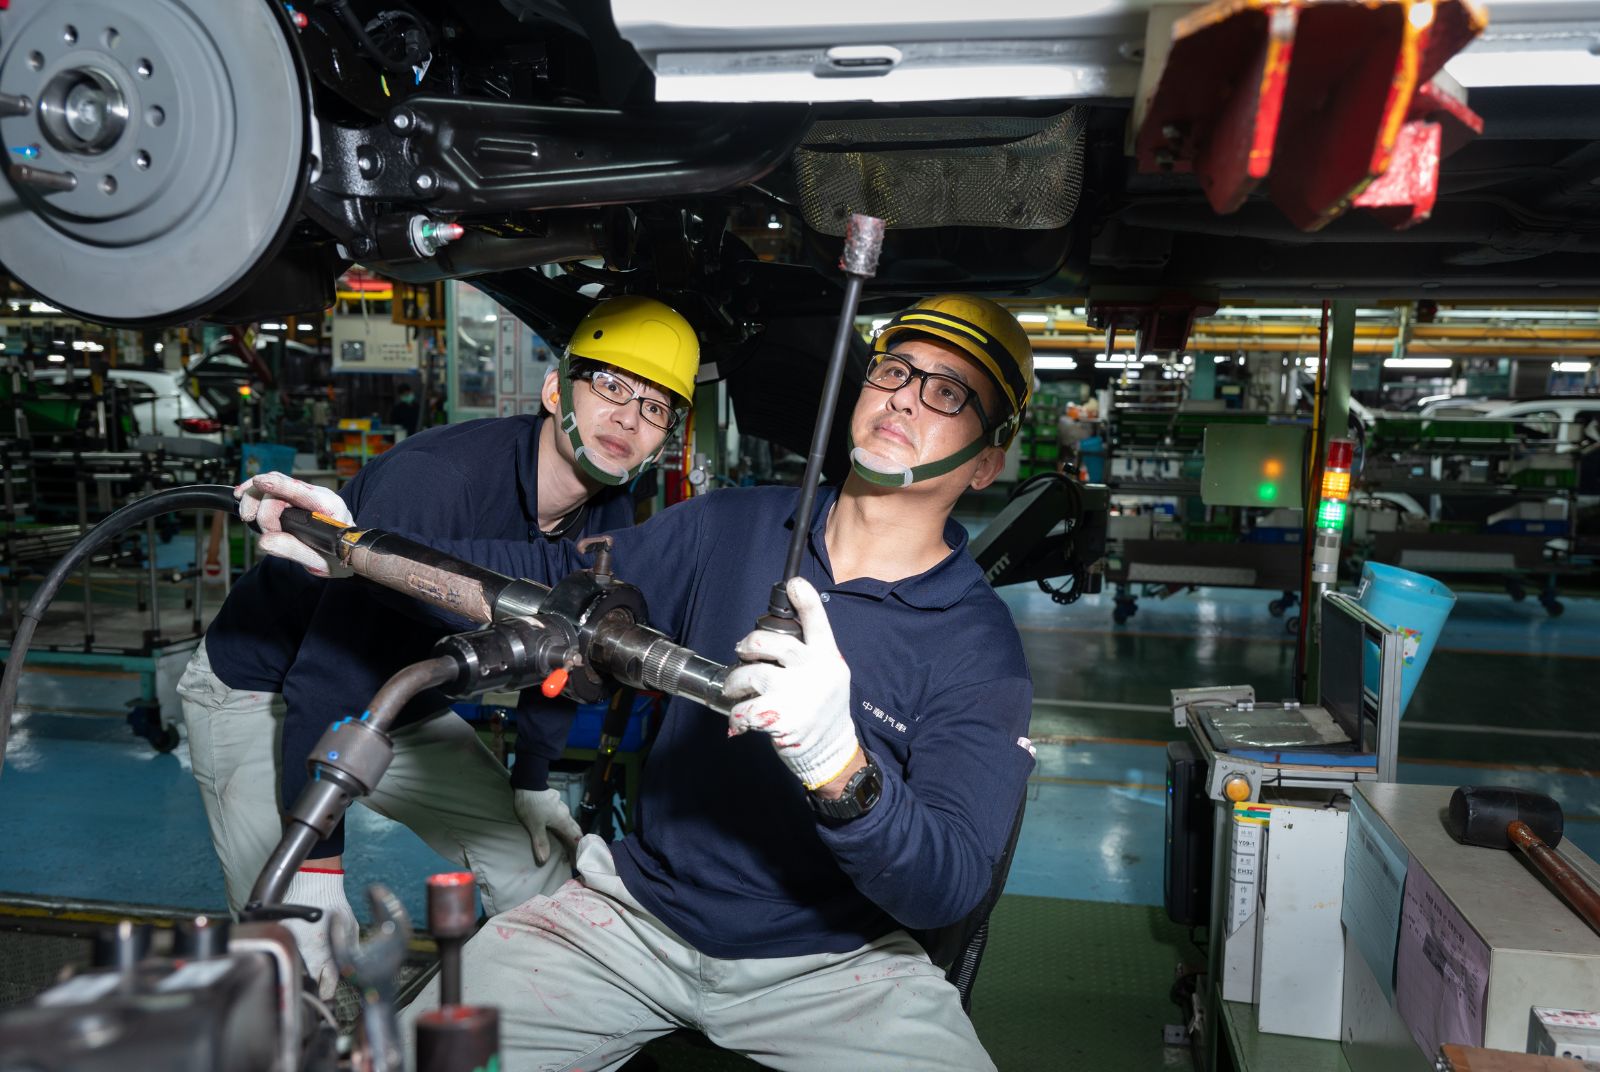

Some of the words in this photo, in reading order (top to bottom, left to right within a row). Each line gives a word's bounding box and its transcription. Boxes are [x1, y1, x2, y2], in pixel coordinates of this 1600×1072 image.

[862, 701, 907, 733] 中華汽車
[1237, 867, 1254, 876] EH32
